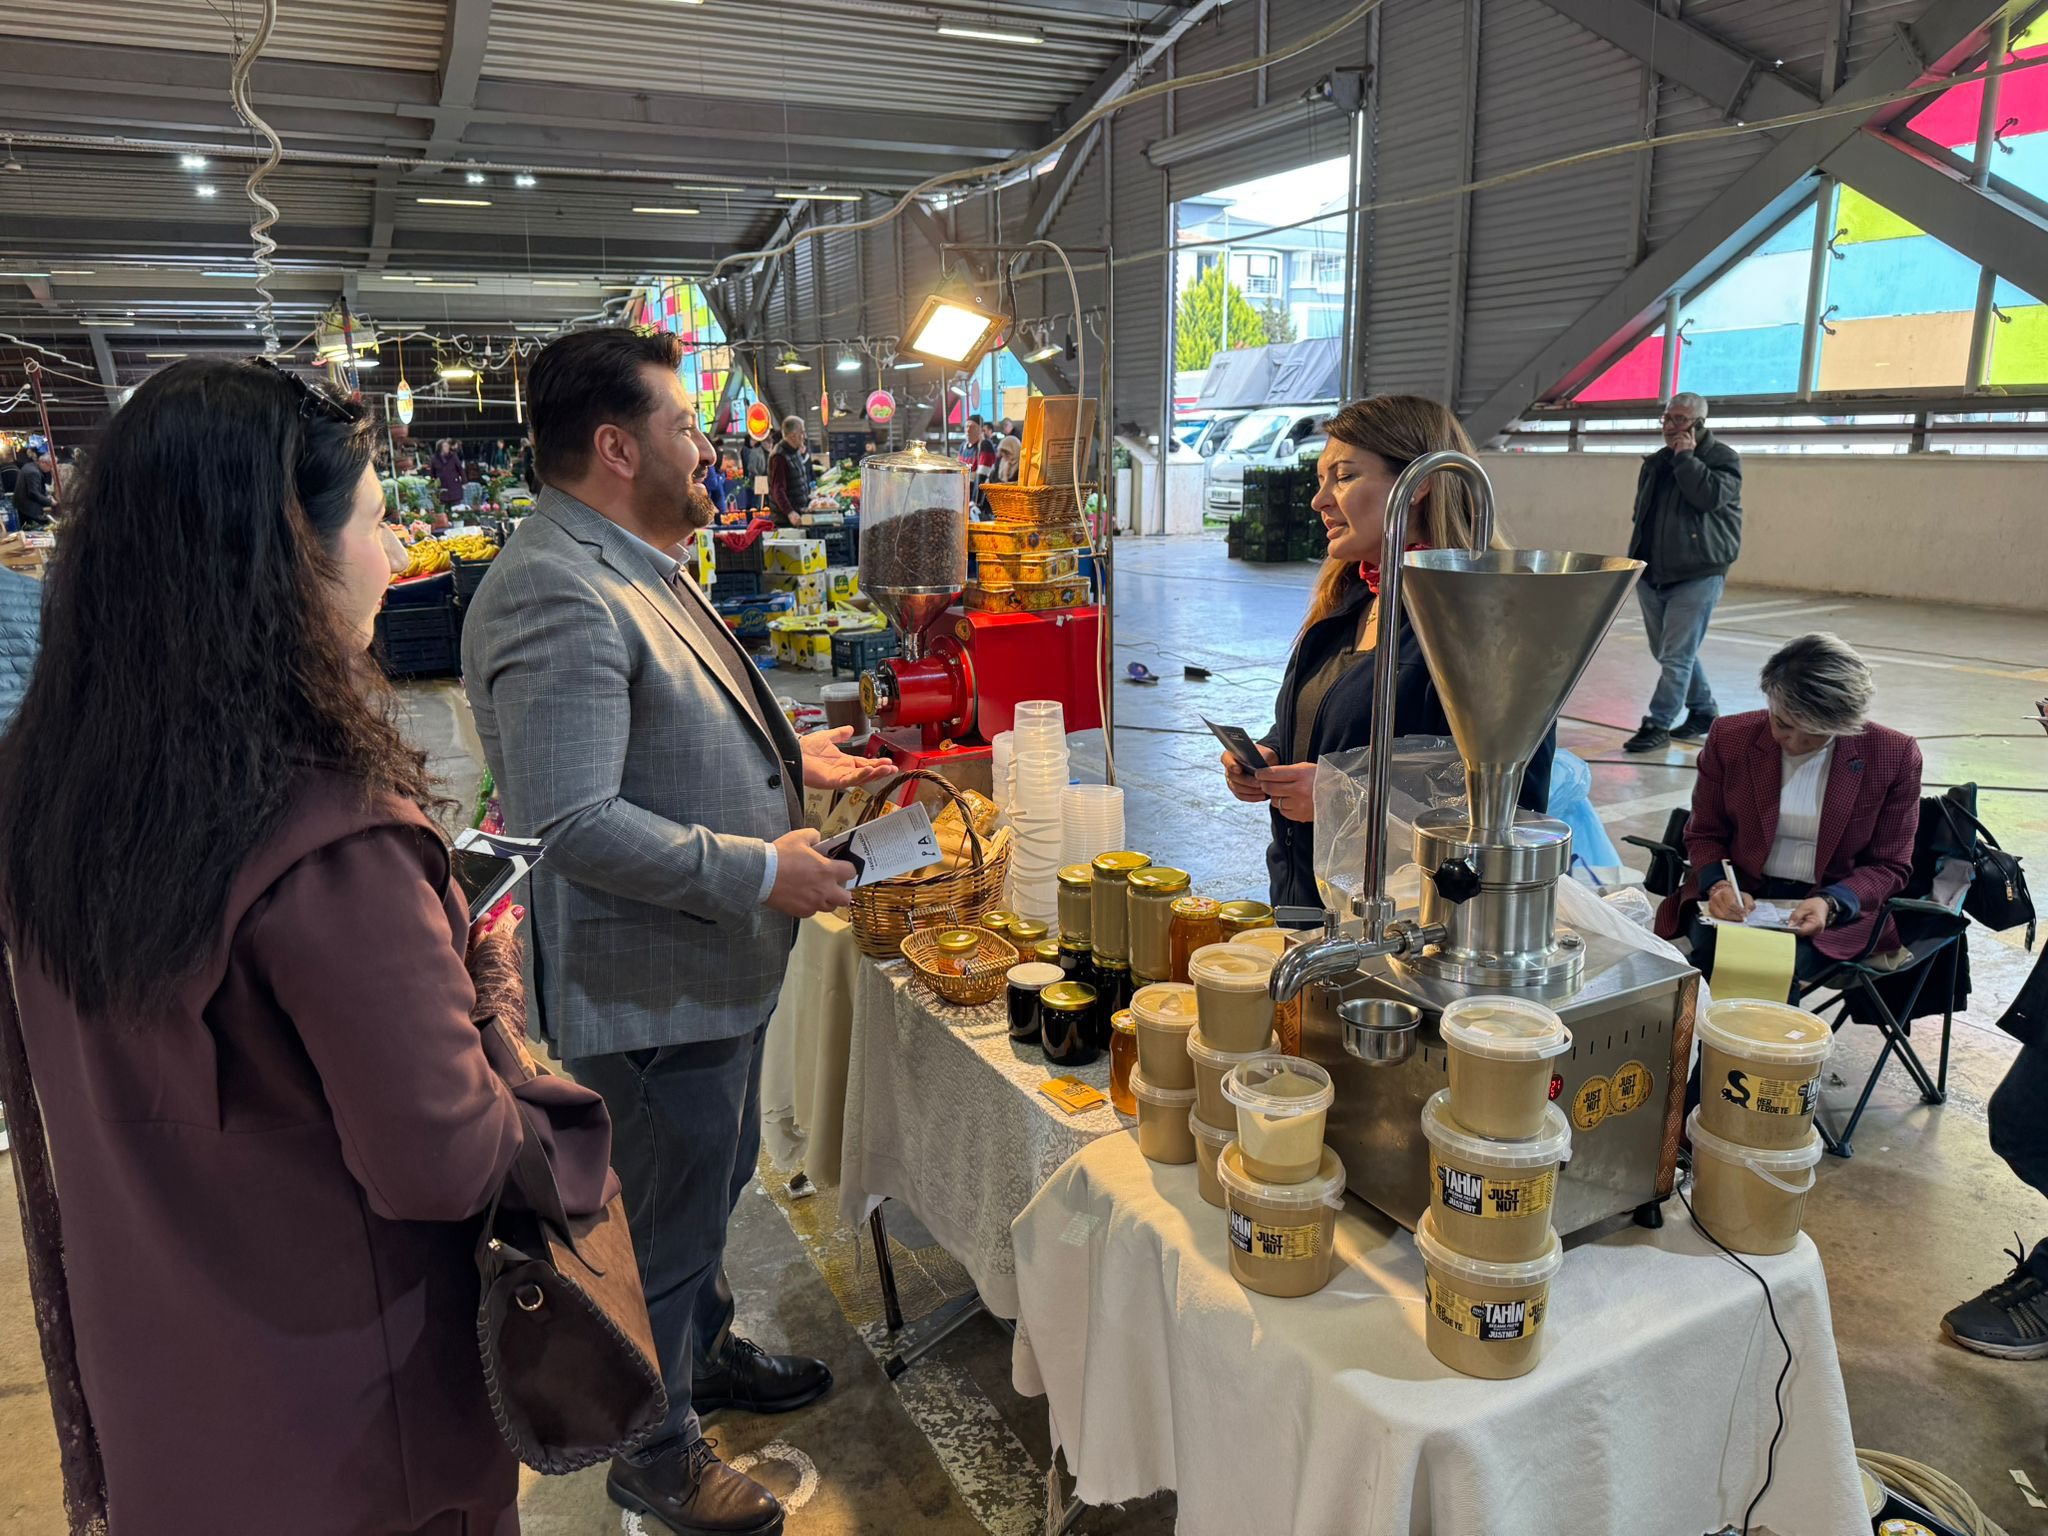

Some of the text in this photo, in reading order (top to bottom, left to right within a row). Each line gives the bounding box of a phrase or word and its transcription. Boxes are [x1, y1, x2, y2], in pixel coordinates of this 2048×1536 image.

[1618, 1074, 1637, 1087] JUST
[1583, 1089, 1602, 1103] JUST
[1622, 1085, 1635, 1096] NUT
[1586, 1100, 1600, 1112] NUT
[1445, 1166, 1480, 1199] TAHİN
[1488, 1189, 1519, 1200] JUST
[1496, 1201, 1519, 1212] NUT
[1257, 1231, 1283, 1244] JUST
[1263, 1243, 1283, 1255] NUT
[1484, 1301, 1525, 1323] TAHİN
[1488, 1330, 1519, 1338] JUSTNUT
